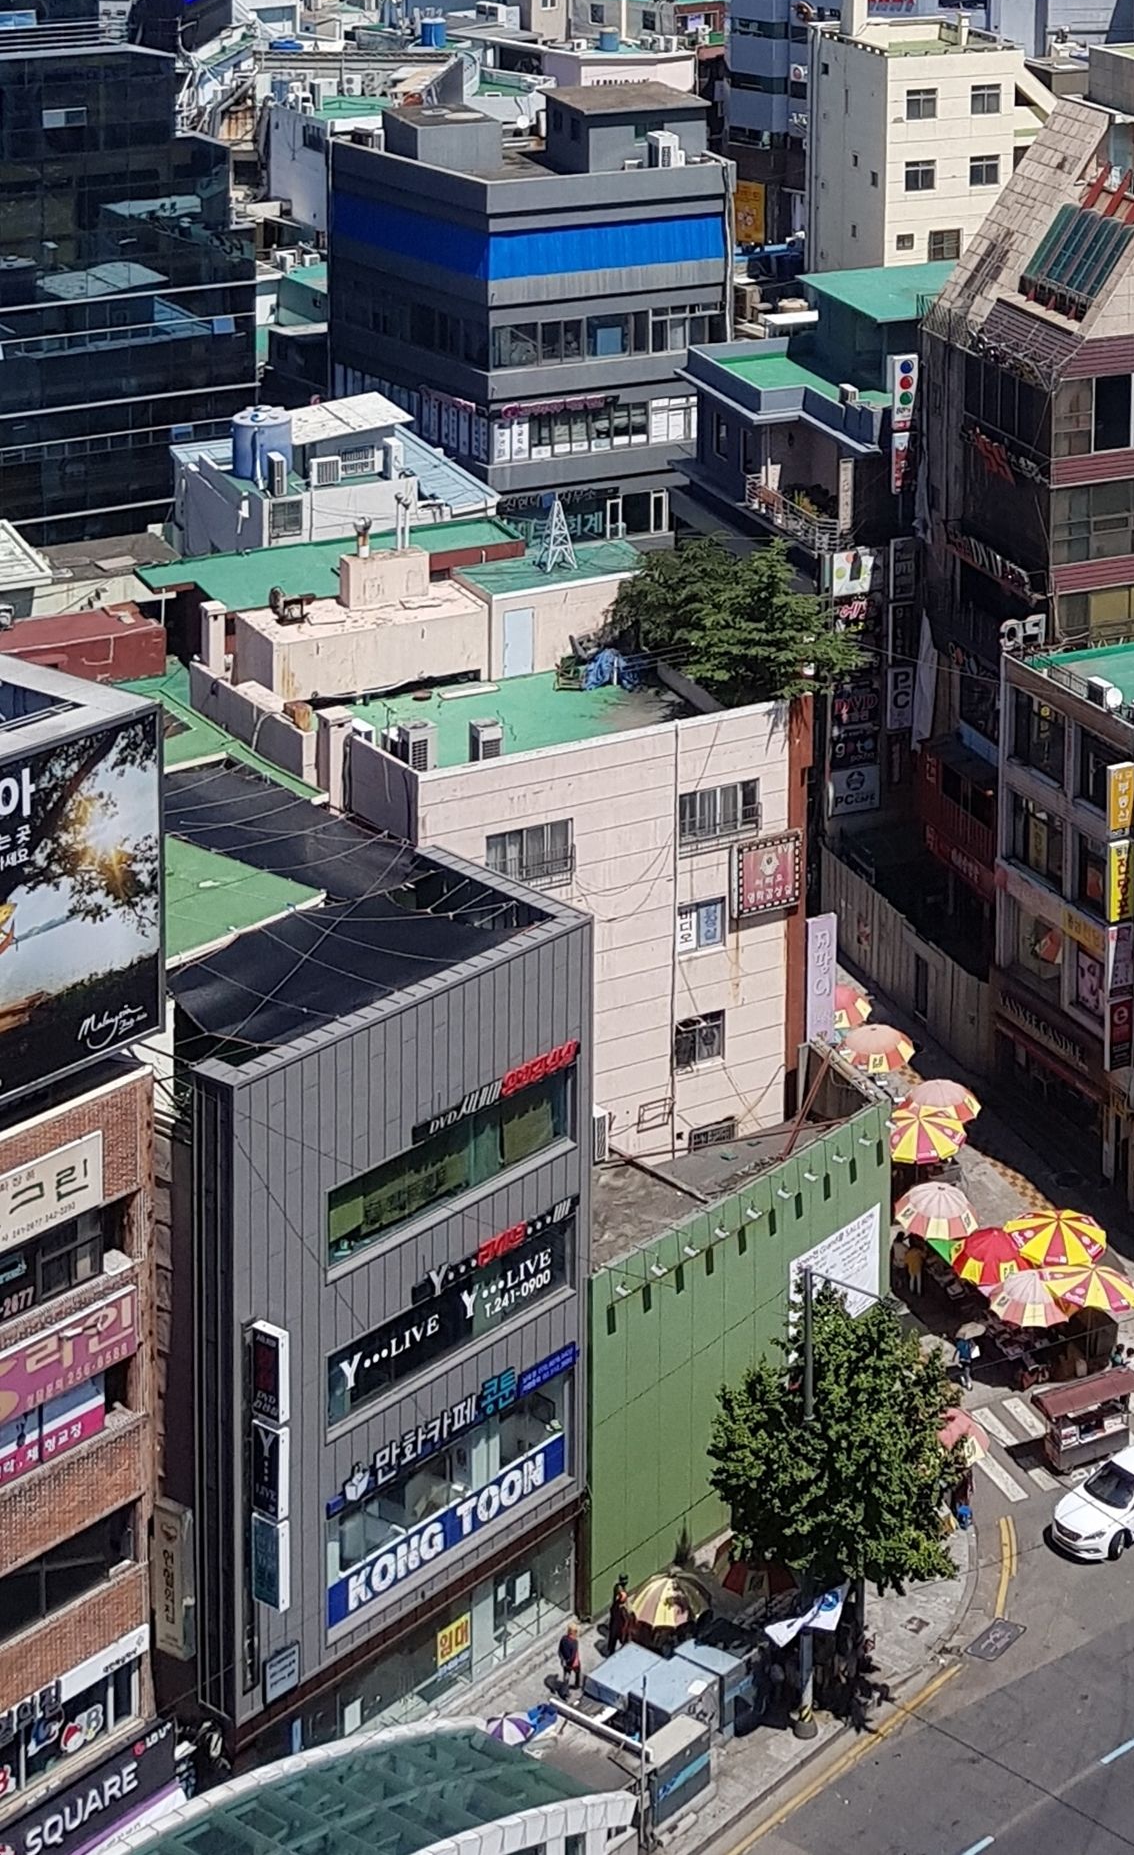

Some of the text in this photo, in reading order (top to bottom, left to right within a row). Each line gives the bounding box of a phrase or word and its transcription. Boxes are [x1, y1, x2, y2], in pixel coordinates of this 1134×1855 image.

[893, 672, 910, 709] PC
[1118, 782, 1130, 822] 부동산
[1117, 858, 1130, 917] 전당포
[9, 1158, 89, 1215] 그린
[484, 1270, 551, 1319] T.241-0900
[374, 1396, 478, 1486] 만화카페
[480, 1366, 519, 1415] 콩툰
[348, 1521, 446, 1611] KONG
[456, 1453, 546, 1536] TOON
[440, 1620, 468, 1659] 임대
[25, 1761, 139, 1855] SQUARE
